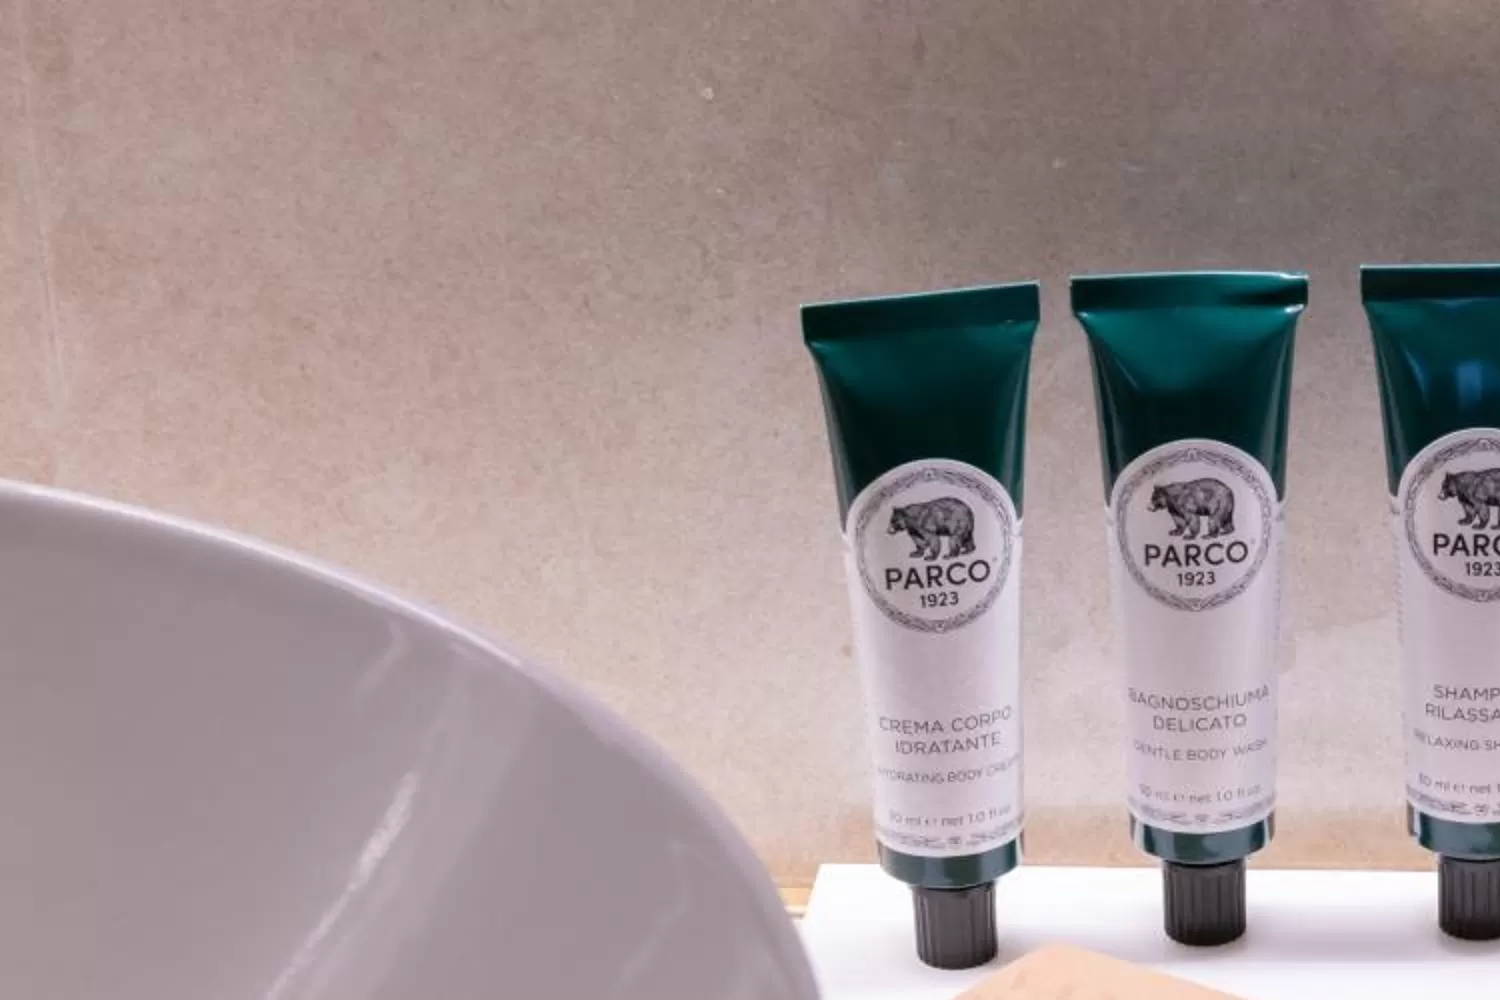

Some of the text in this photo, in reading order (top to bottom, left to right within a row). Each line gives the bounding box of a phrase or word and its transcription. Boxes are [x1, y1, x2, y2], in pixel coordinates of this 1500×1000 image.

[1144, 541, 1248, 567] PARCO
[885, 559, 991, 591] PARCO
[1177, 571, 1216, 587] 1923
[920, 592, 959, 608] 1923
[1128, 684, 1269, 712] BAGNOSCHIUMA
[879, 705, 1012, 736] CREMA CORPO
[1153, 714, 1247, 732] DELICATO
[896, 731, 1001, 755] IDRATANTE
[1186, 750, 1226, 761] BODY
[948, 767, 983, 783] BODY
